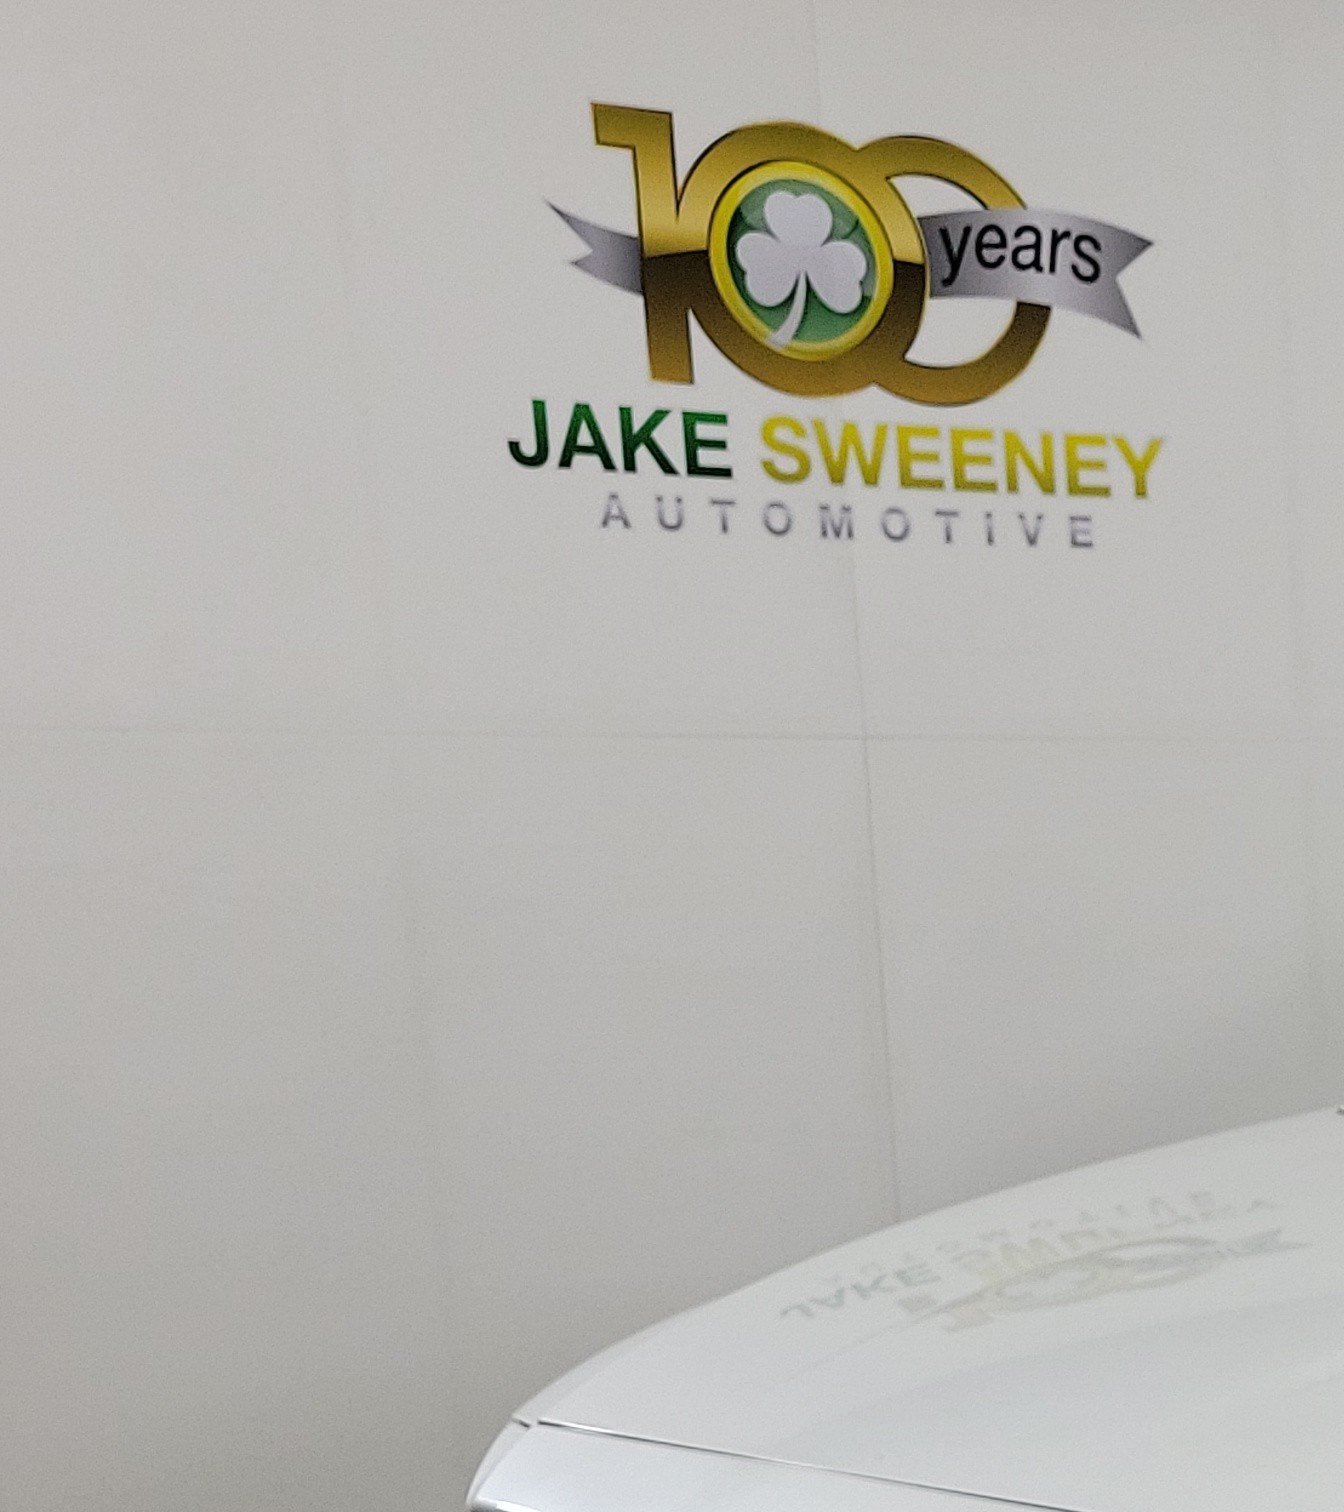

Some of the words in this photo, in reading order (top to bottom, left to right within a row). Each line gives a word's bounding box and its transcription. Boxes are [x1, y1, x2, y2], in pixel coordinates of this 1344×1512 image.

[591, 102, 1052, 407] 100
[938, 216, 1102, 287] years
[508, 399, 733, 479] JAKE
[760, 415, 1164, 500] SWEENEY
[602, 493, 1095, 548] AUTOMOTIVE
